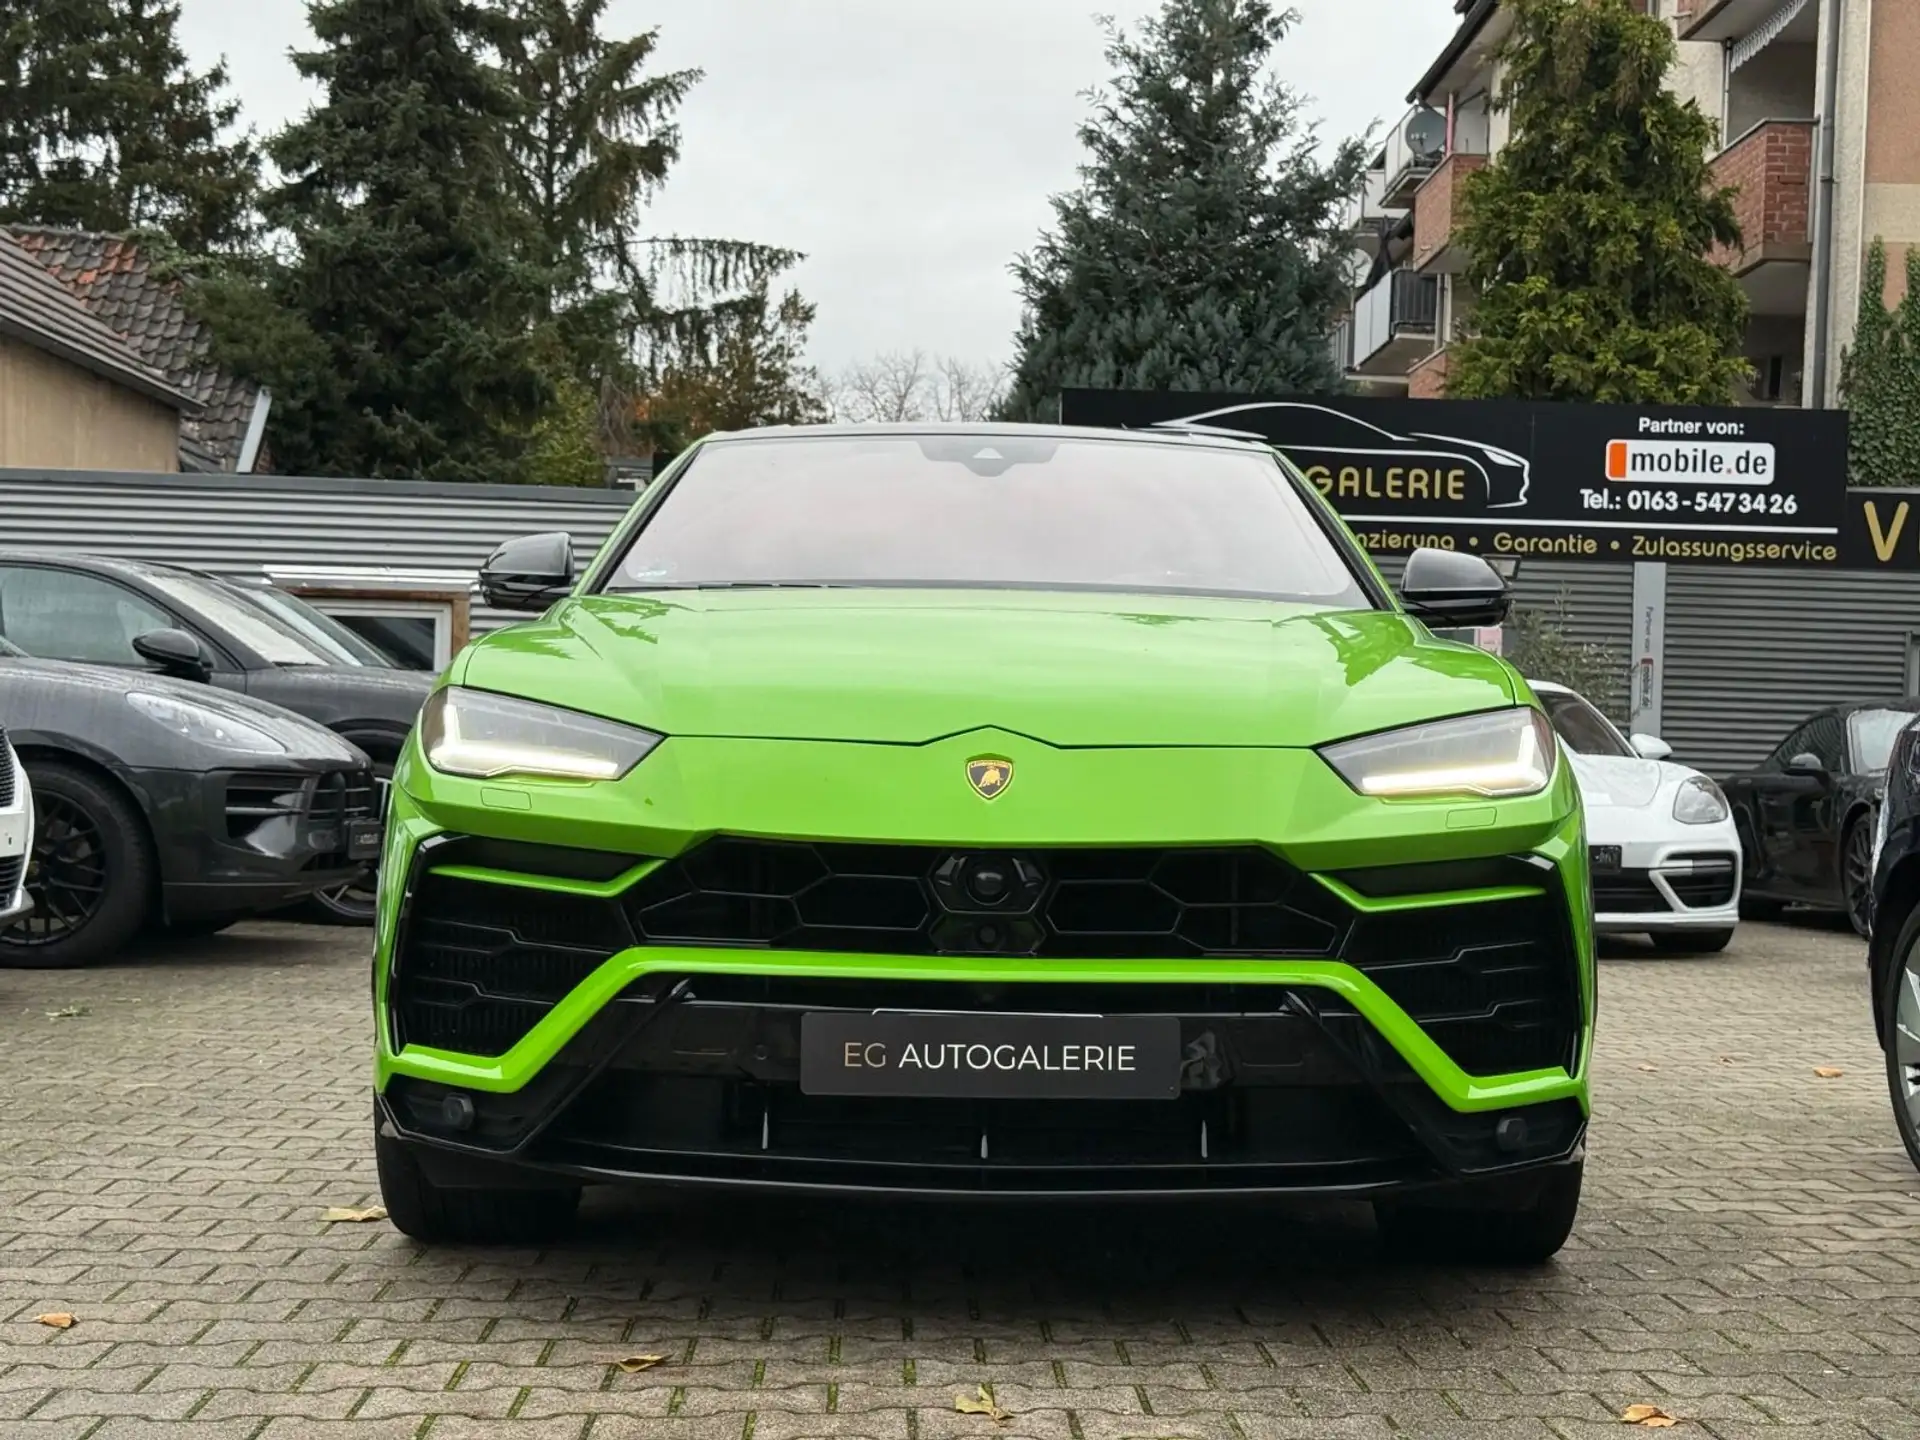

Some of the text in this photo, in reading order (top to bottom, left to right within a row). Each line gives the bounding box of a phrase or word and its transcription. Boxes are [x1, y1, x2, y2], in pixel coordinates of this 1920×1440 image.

[1638, 416, 1745, 436] Partner von:
[1631, 448, 1767, 475] mobile.de
[1580, 488, 1621, 511] Tel.:
[1863, 500, 1920, 562] V
[1493, 532, 1597, 553] Garantie
[1631, 535, 1837, 561] Zulassungsservice
[844, 1042, 1136, 1071] EG AUTOGALERIE
